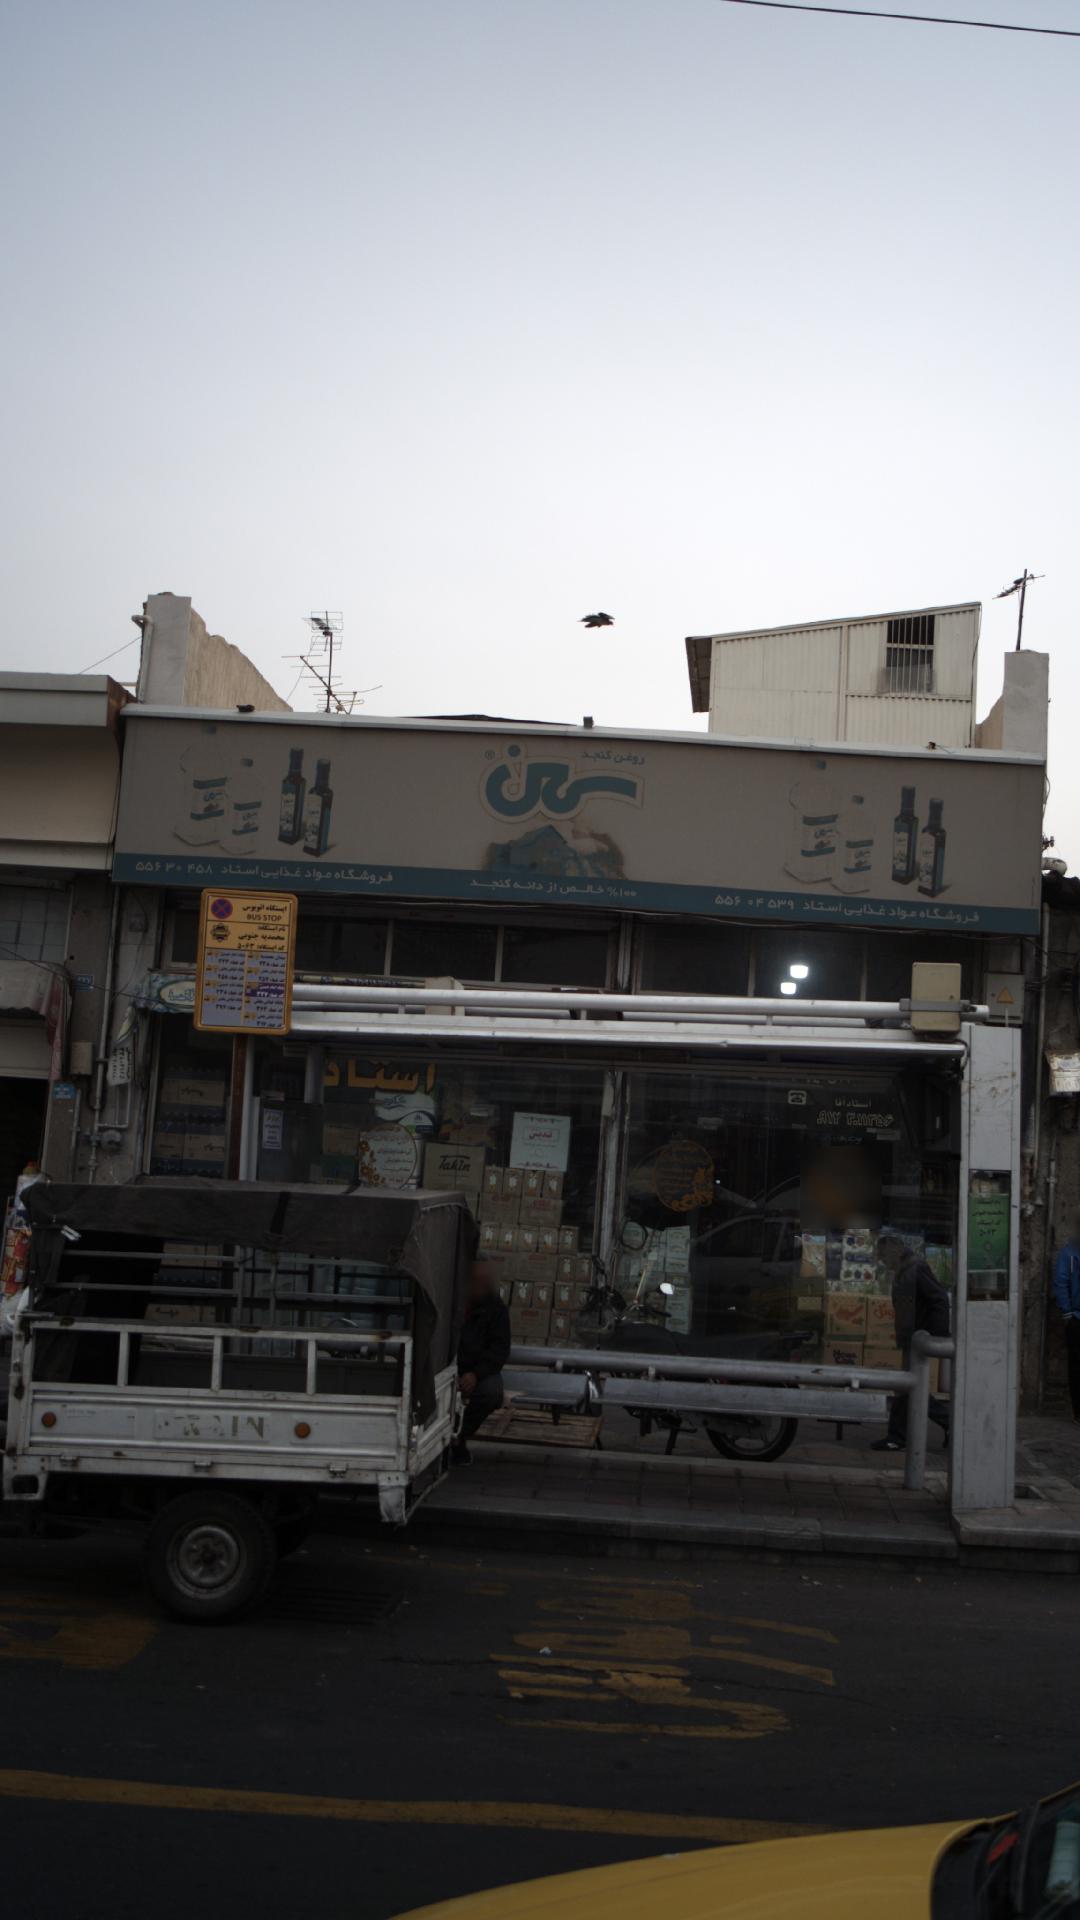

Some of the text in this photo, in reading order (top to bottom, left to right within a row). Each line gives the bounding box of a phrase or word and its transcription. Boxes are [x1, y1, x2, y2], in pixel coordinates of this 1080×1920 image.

[581, 750, 645, 765] روغن کنجد
[135, 860, 393, 884] فروشگاه مواد غذایی استاد ۴۵۸ ۳۰ ۵۵۶
[469, 878, 512, 890] کنجد
[513, 880, 543, 891] دانه
[546, 880, 558, 894] از
[559, 882, 605, 895] خالص
[714, 894, 741, 905] ۵۵۶
[767, 898, 795, 910] ۵۳۹
[242, 903, 288, 913] ایستگاه اتوبوس
[802, 901, 843, 913] استاد
[843, 901, 886, 916] غذایی
[888, 905, 918, 918] مواد
[246, 913, 282, 922] BUS STOP
[919, 905, 980, 923] فروشگاه
